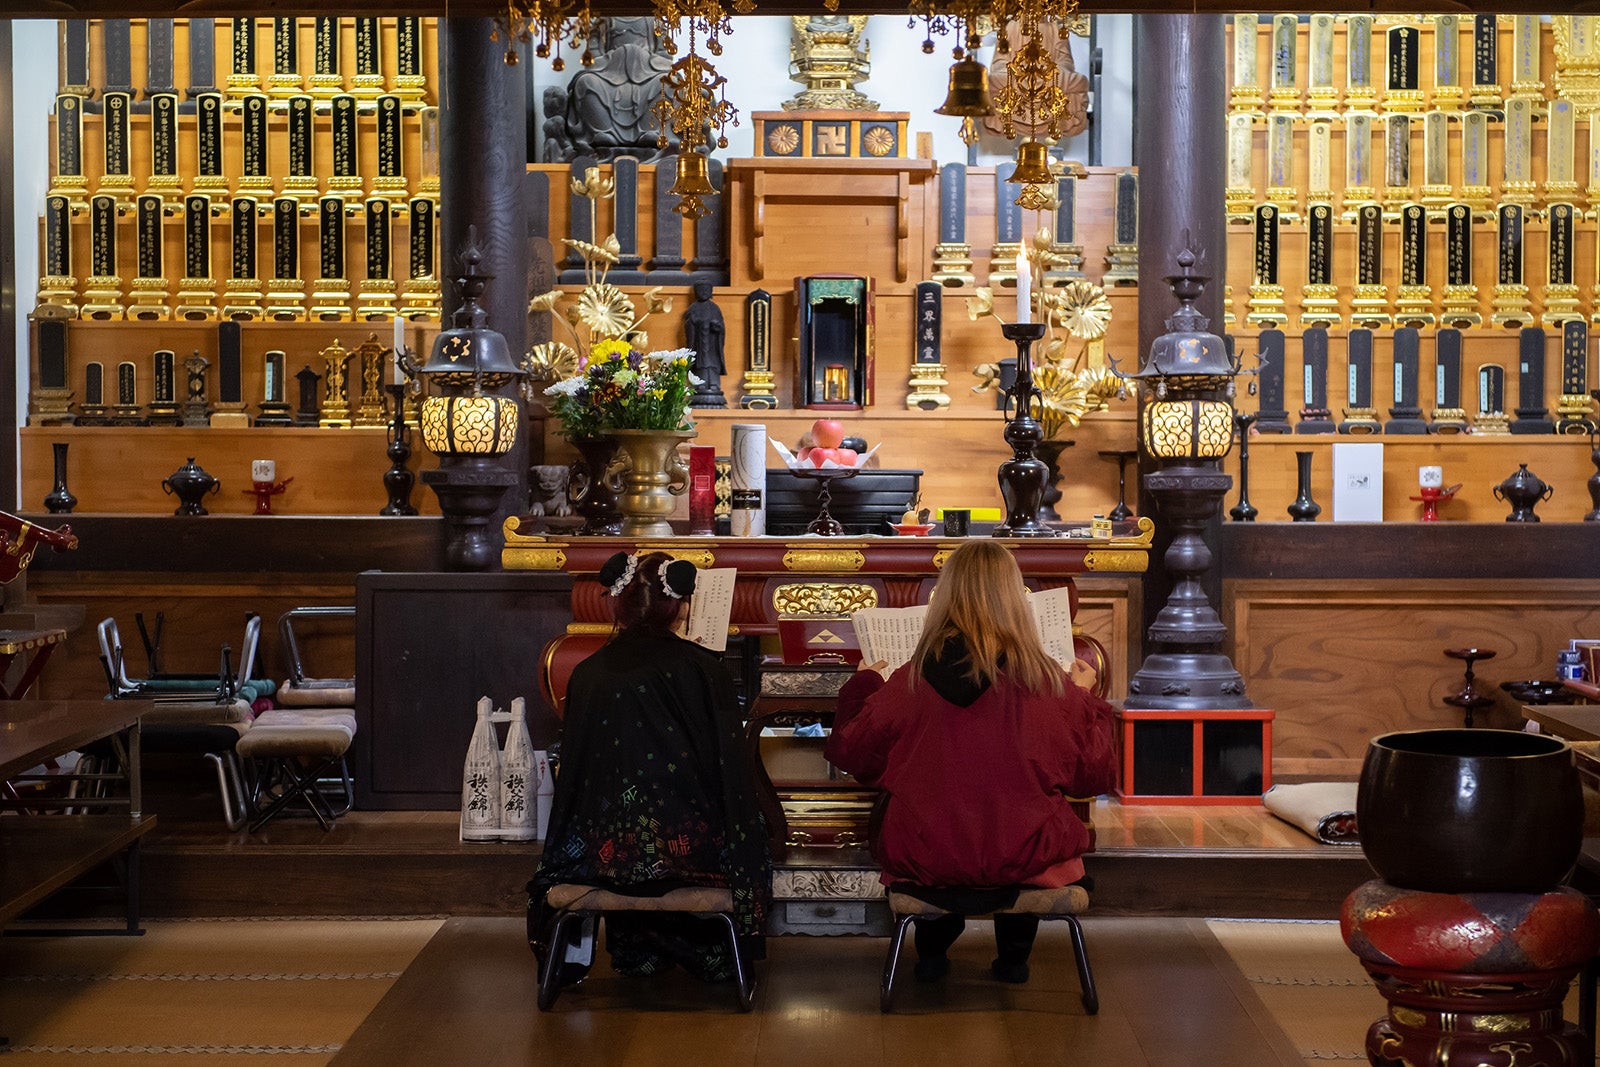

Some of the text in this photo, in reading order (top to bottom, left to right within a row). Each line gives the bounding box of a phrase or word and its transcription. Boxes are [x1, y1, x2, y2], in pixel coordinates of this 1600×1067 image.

[467, 773, 488, 818] 秩父錦
[503, 773, 525, 818] 秩父錦
